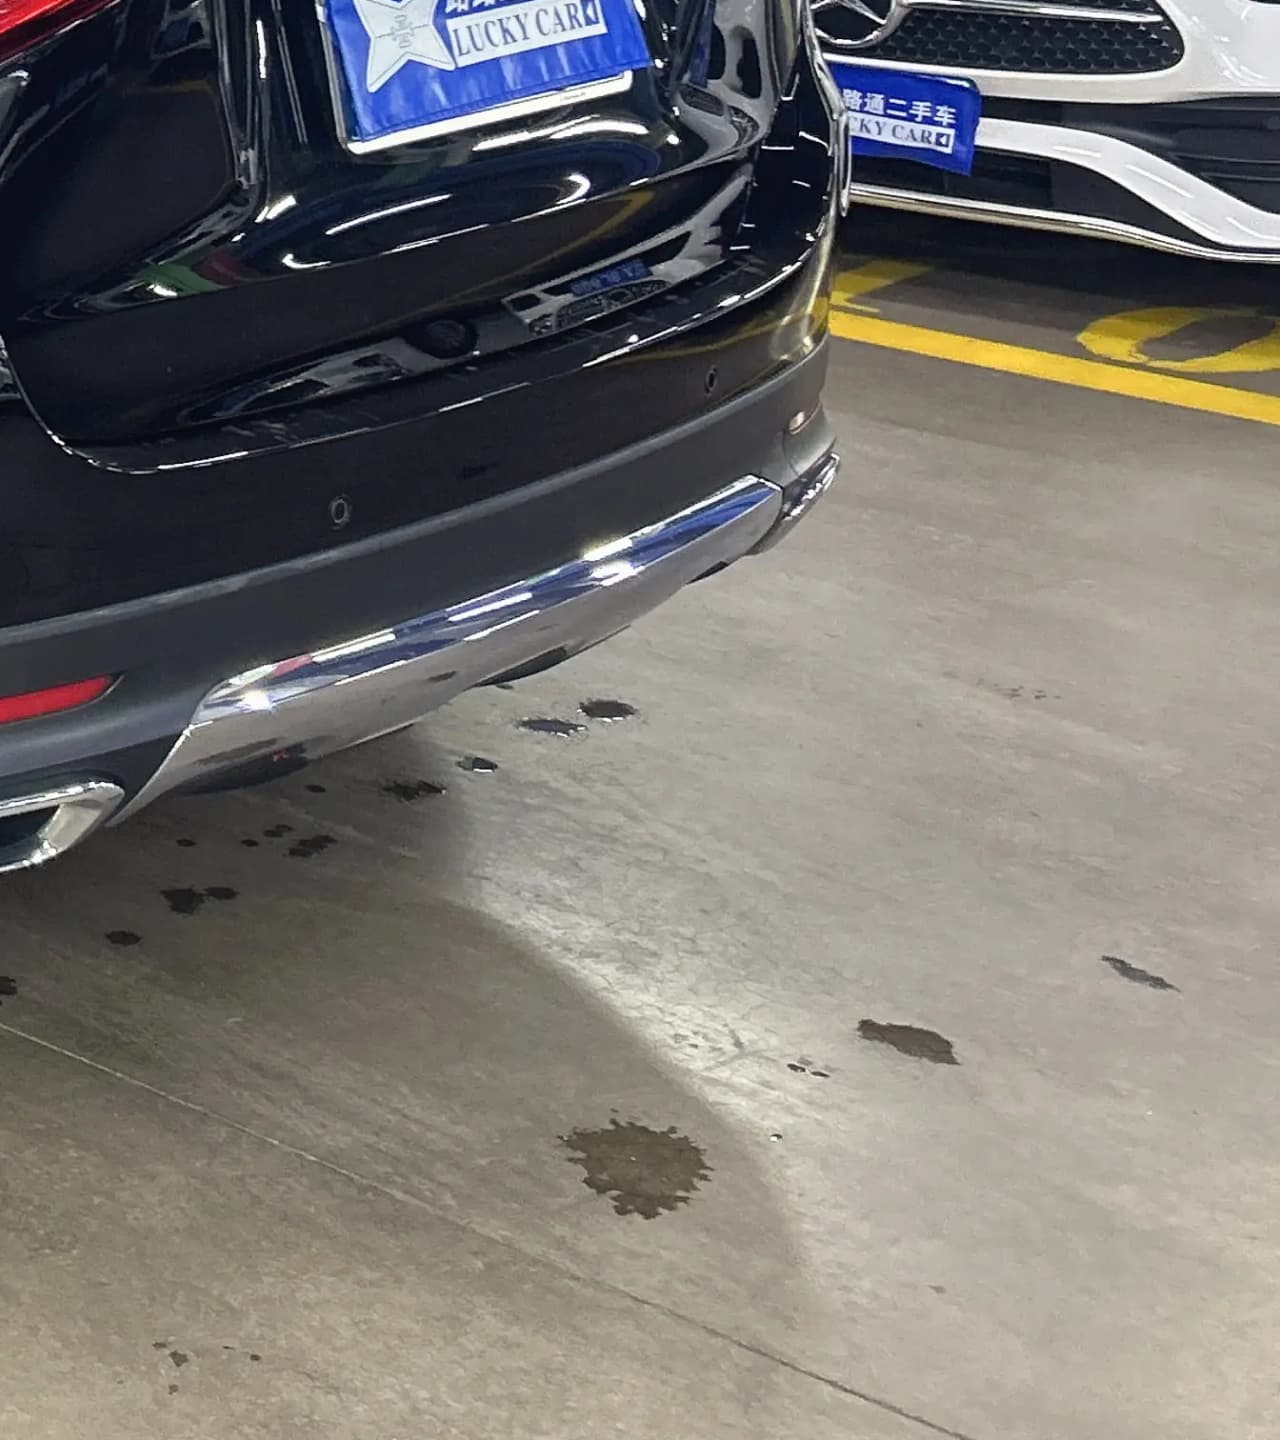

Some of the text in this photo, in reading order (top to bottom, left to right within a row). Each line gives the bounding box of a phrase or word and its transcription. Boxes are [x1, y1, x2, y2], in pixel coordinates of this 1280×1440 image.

[452, 10, 535, 58] LUCKY
[535, 1, 582, 37] CAR
[891, 123, 932, 146] CAR
